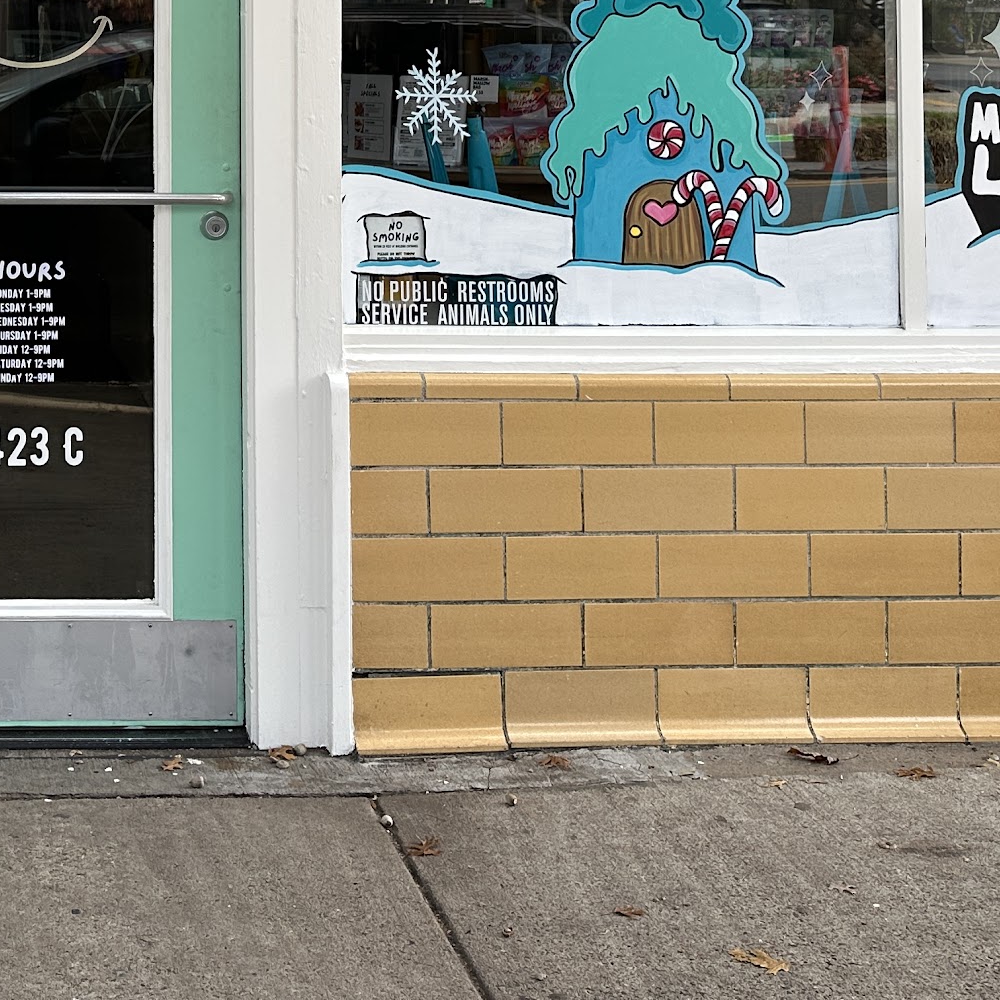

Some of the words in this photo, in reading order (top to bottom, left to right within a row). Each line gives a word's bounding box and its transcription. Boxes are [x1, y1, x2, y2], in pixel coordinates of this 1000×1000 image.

[388, 221, 403, 232] NO
[372, 232, 419, 243] SMOKING
[26, 289, 51, 299] 1-9PM
[362, 281, 384, 303] NO
[389, 280, 448, 303] PUBLIC
[457, 280, 555, 303] RESTROOMS
[28, 302, 53, 313] 1-9PM
[361, 303, 428, 325] SERVICE
[438, 303, 508, 325] ANIMALS
[514, 303, 553, 325] ONLY
[41, 316, 65, 326] 1-9PM
[34, 330, 58, 340] 1-9PM
[21, 344, 51, 354] 12-9PM
[34, 359, 64, 368] 12-9PM
[25, 373, 55, 383] 12-9PM
[62, 426, 84, 466] C
